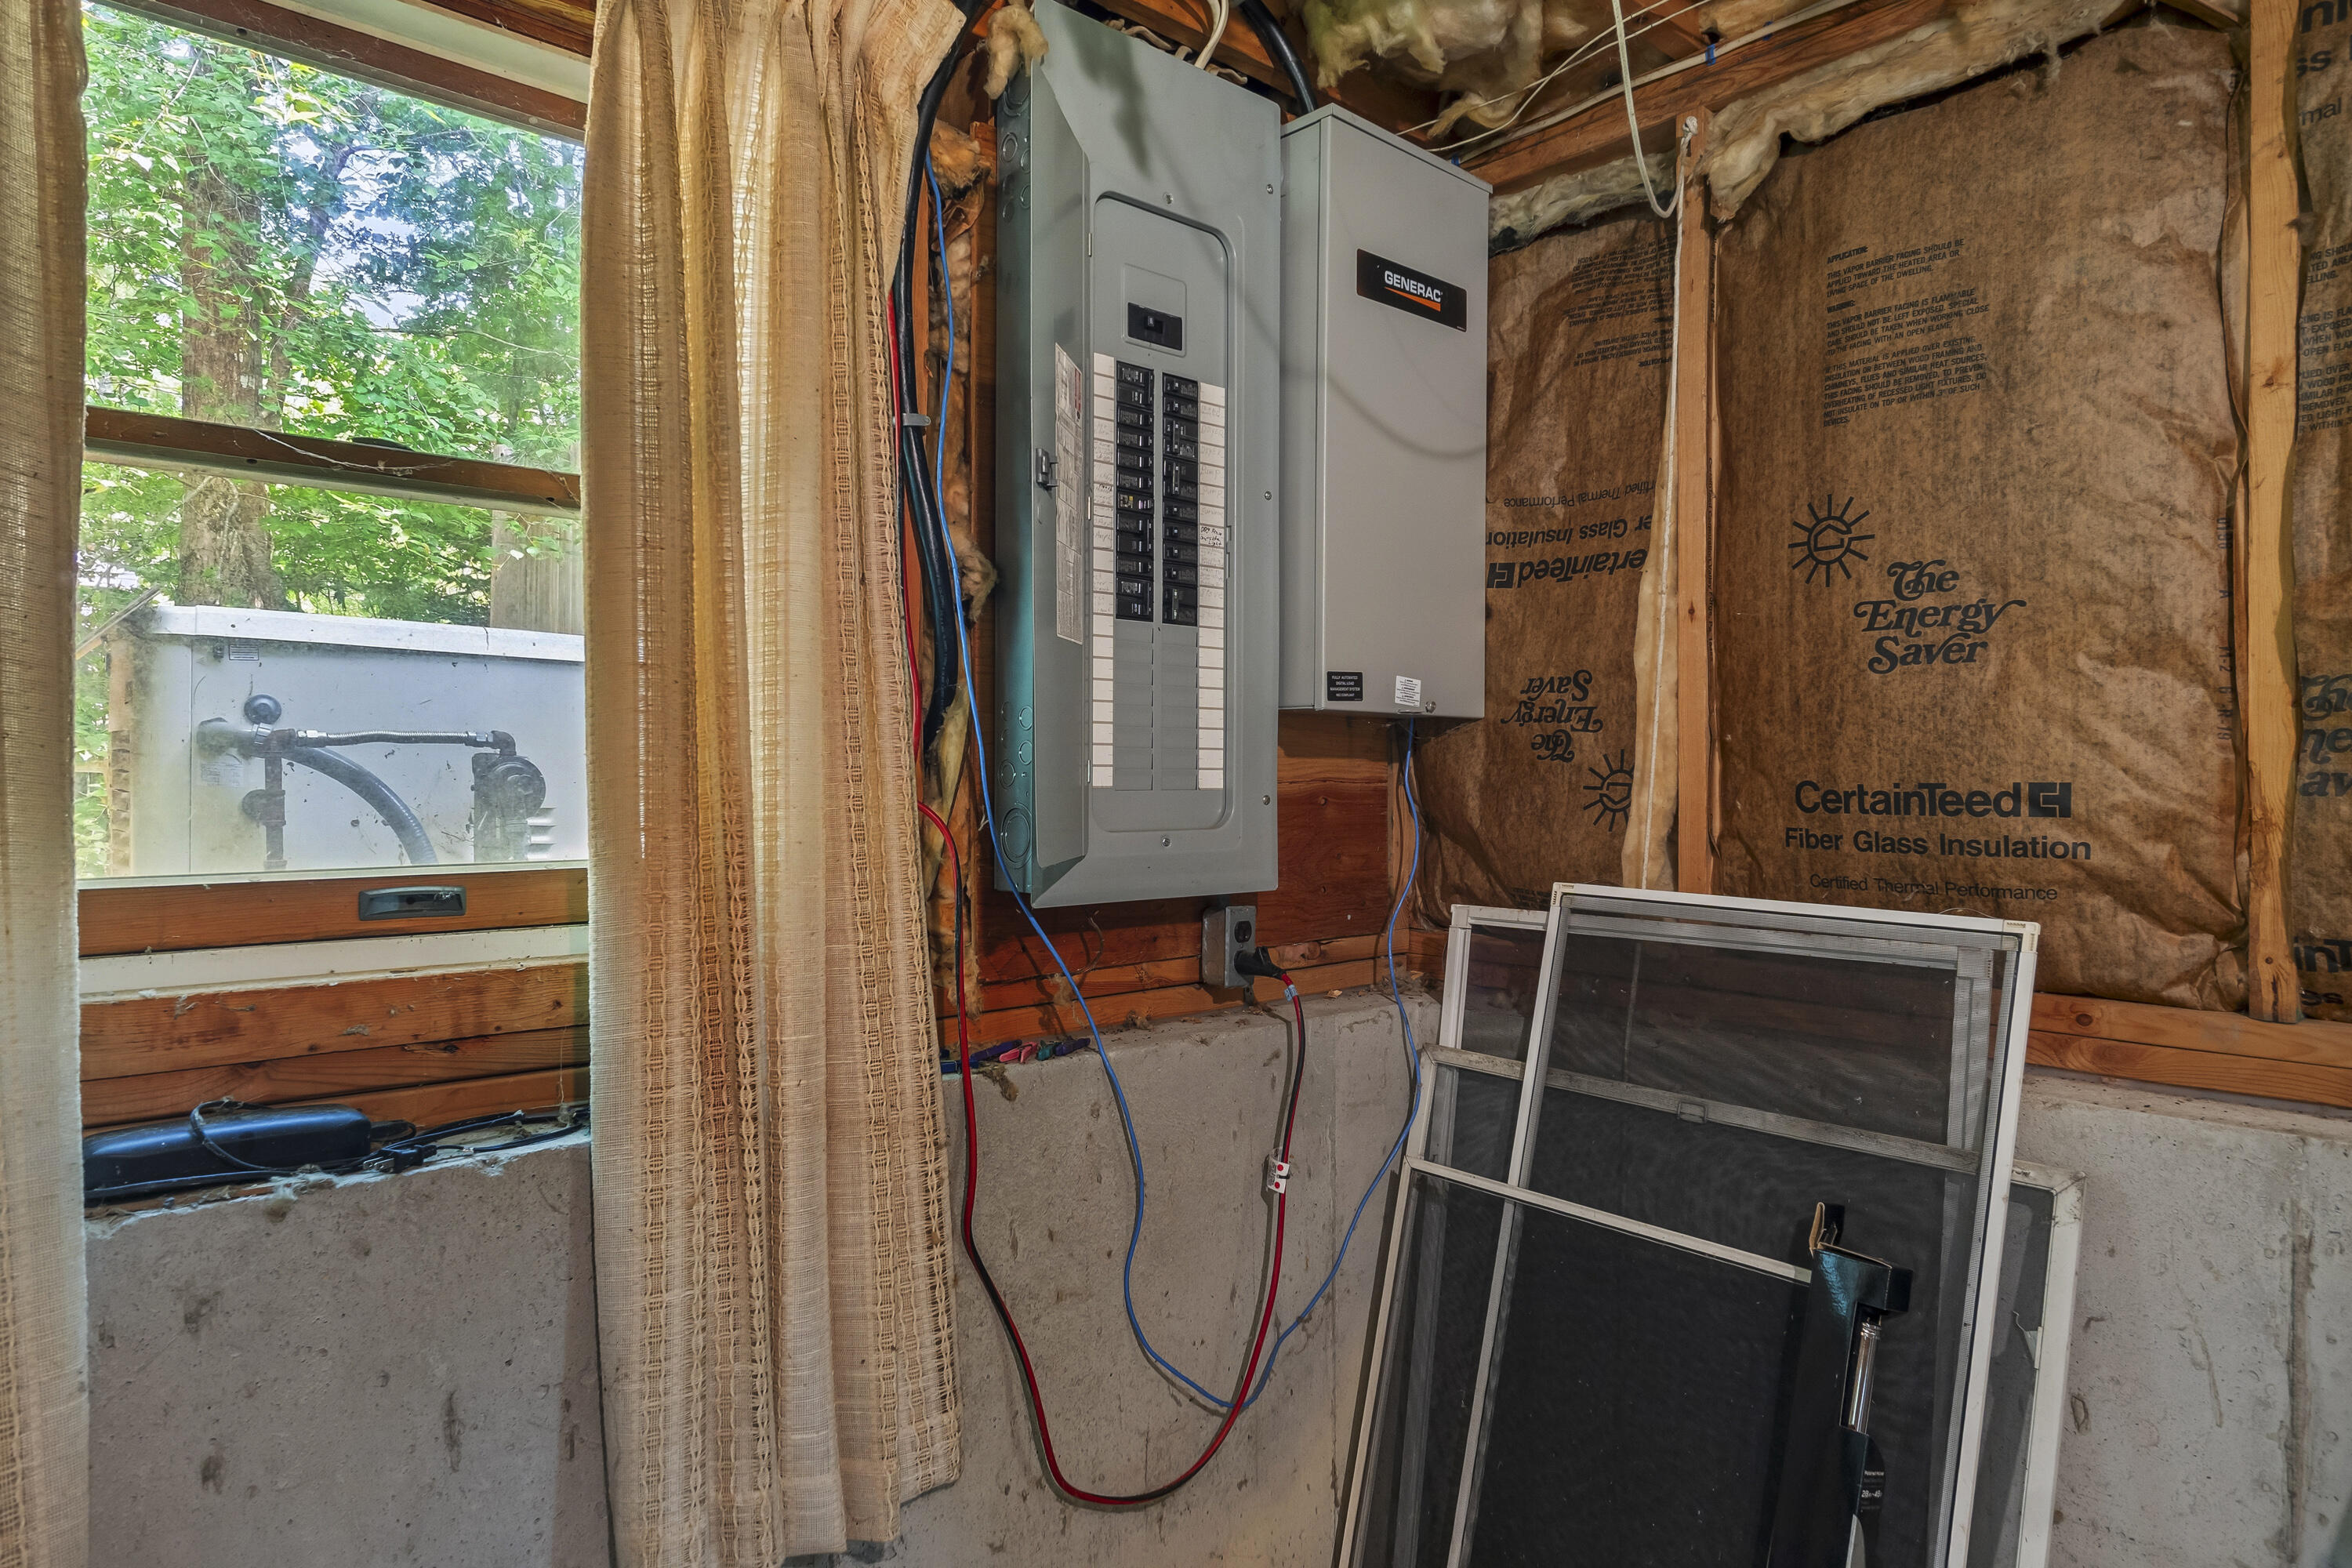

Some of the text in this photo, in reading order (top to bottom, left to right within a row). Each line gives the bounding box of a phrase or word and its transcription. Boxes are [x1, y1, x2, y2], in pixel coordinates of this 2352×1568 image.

[1827, 238, 1964, 280] THIS VAPOR BARRIER FACING SHOULD BE
[1827, 249, 1958, 289] APPLIED TOWARD THE HEATED AREA OR
[1385, 270, 1442, 303] GENERAC
[1827, 287, 1846, 298] LIVING
[1849, 280, 1868, 291] SPACE
[1882, 273, 1894, 282] THE
[1827, 320, 1840, 329] THIS
[1842, 314, 1861, 325] VAPOR
[1864, 307, 1891, 318] BARRIER
[1894, 300, 1918, 312] FACING
[1827, 330, 1839, 339] AND
[1842, 323, 1864, 334] SHOULD
[1867, 318, 1879, 327] NOT
[1894, 312, 1909, 321] LEFT
[1948, 297, 1978, 310] SPECIAL
[1827, 338, 1842, 347] CARE
[1845, 331, 1867, 343] SHOULD
[1881, 322, 1903, 333] TAKEN
[1906, 317, 1927, 328] WHEN
[1930, 309, 1962, 323] WORKING
[1966, 304, 1988, 316] CLOSE
[1833, 362, 1846, 372] THIS
[1849, 354, 1879, 368] MATERIAL
[1891, 347, 1918, 358] APPLIED
[1922, 342, 1940, 352] OVER
[1943, 336, 1975, 348] EXISTING
[1849, 339, 1871, 350] FACING
[1875, 334, 1891, 343] WITH
[1906, 327, 1924, 336] OPEN
[2303, 334, 2331, 346] WHEN
[2303, 346, 2328, 357] OPEN
[1824, 368, 1860, 382] INSULATION
[1874, 358, 1905, 371] BETWEEN
[1908, 354, 1929, 364] WOOD
[1932, 347, 1963, 360] FRAMING
[1966, 343, 1982, 353] AND
[1860, 373, 1879, 383] FLUES
[1882, 369, 1896, 379] AND
[1899, 364, 1927, 375] SIMILAR
[1930, 360, 1947, 369] HEAT
[2326, 363, 2350, 375] OVER
[1824, 391, 1838, 400] THIS
[1840, 386, 1861, 397] FACING
[1864, 380, 1890, 391] SHOULD
[1824, 394, 1865, 409] OVERHEATING
[1878, 385, 1912, 397] RECESSED
[1915, 381, 1933, 391] LIGHT
[1975, 372, 1987, 380] DO
[2308, 378, 2335, 389] WOOD
[1824, 409, 1835, 418] NOT
[1837, 403, 1867, 415] INSULATE
[1882, 397, 1895, 406] TOP
[1909, 390, 1934, 401] WITHIN
[1960, 383, 1980, 393] SUCH
[2317, 407, 2344, 419] LIGHT
[2308, 419, 2344, 431] WITHIN
[1504, 480, 1656, 508] rtified Thermal Performance
[1579, 519, 1628, 539] Glass
[1517, 549, 1648, 588] ertainTeed
[1887, 560, 1960, 601] The
[1853, 598, 2027, 638] Energy
[1867, 632, 1988, 674] Saver
[1520, 670, 1593, 702] Saver
[1501, 699, 1603, 733] Energy
[1531, 729, 1574, 762] The
[1795, 780, 2021, 817] CertainTeed
[1785, 827, 2092, 860] Fiber Glass Insulation
[1809, 873, 2057, 901] Certified Thermal Performance
